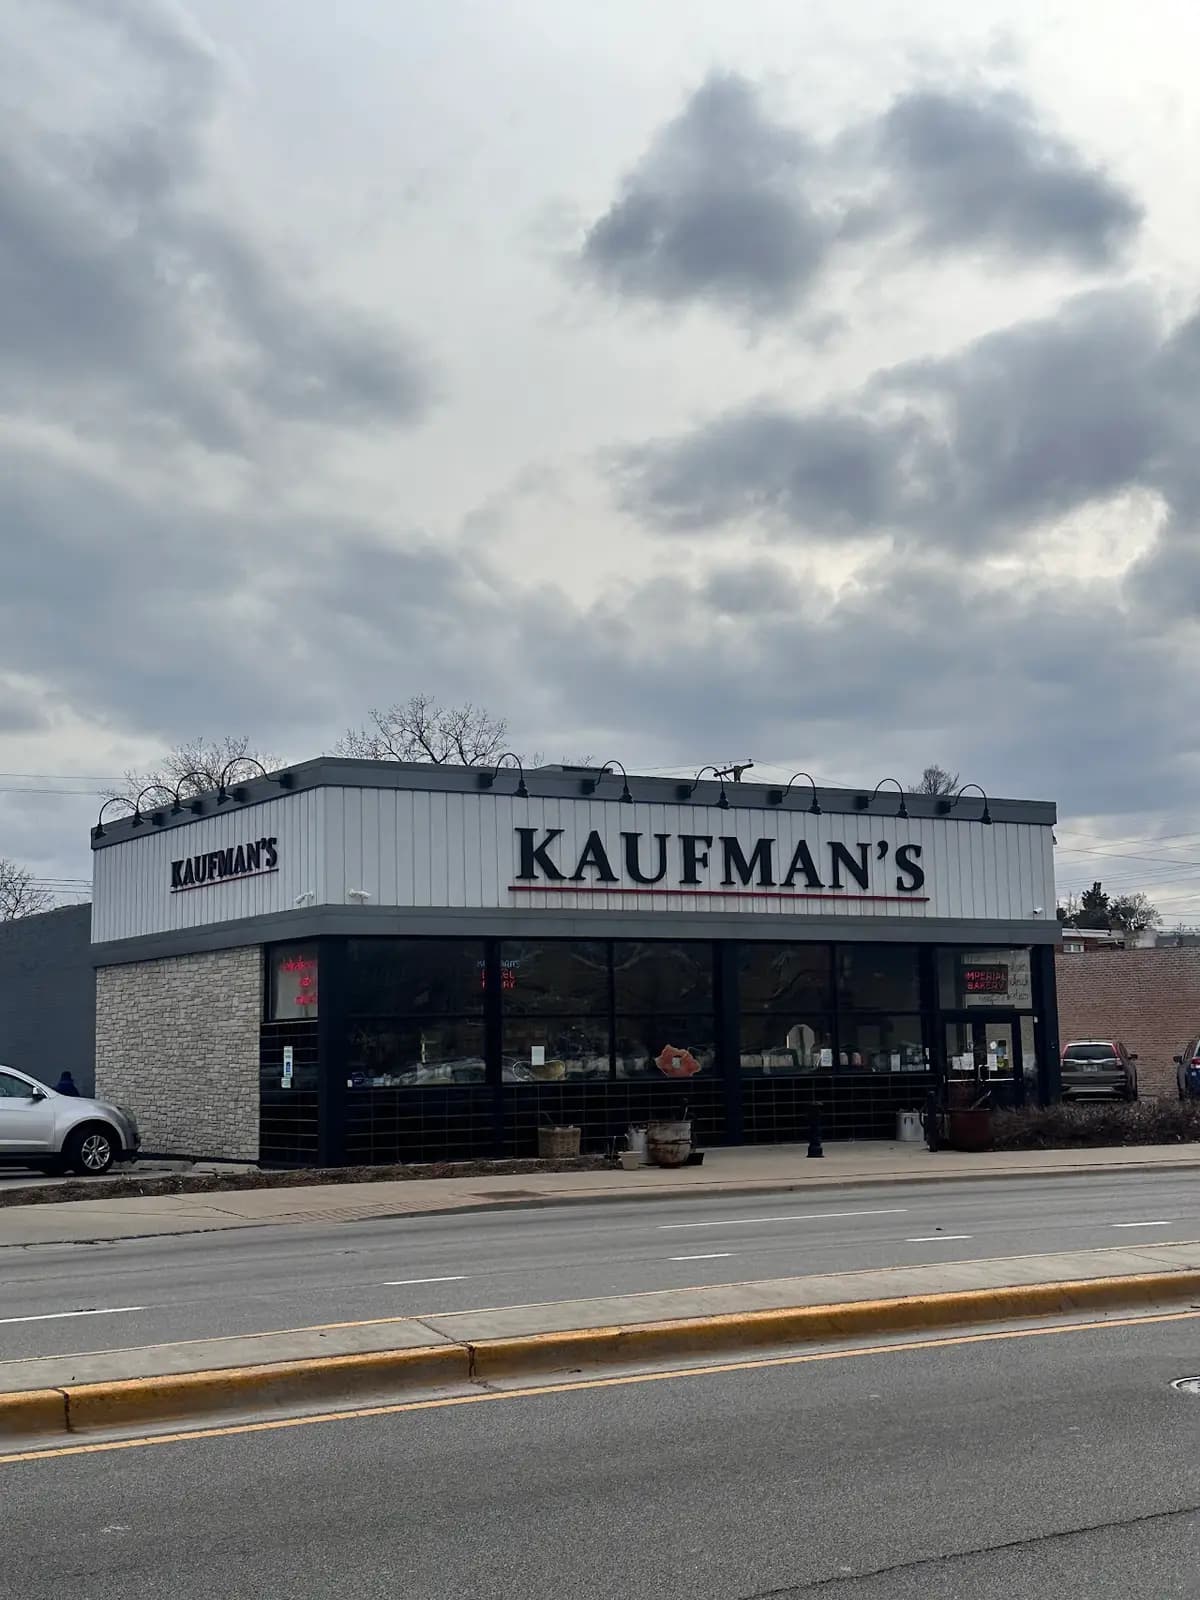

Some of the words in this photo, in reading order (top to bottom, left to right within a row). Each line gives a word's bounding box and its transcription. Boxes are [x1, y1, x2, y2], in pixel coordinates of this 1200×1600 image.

[171, 837, 277, 889] KAUFMAN'S
[514, 827, 925, 891] KAUFMAN'S
[967, 981, 1005, 990] BAKERY
